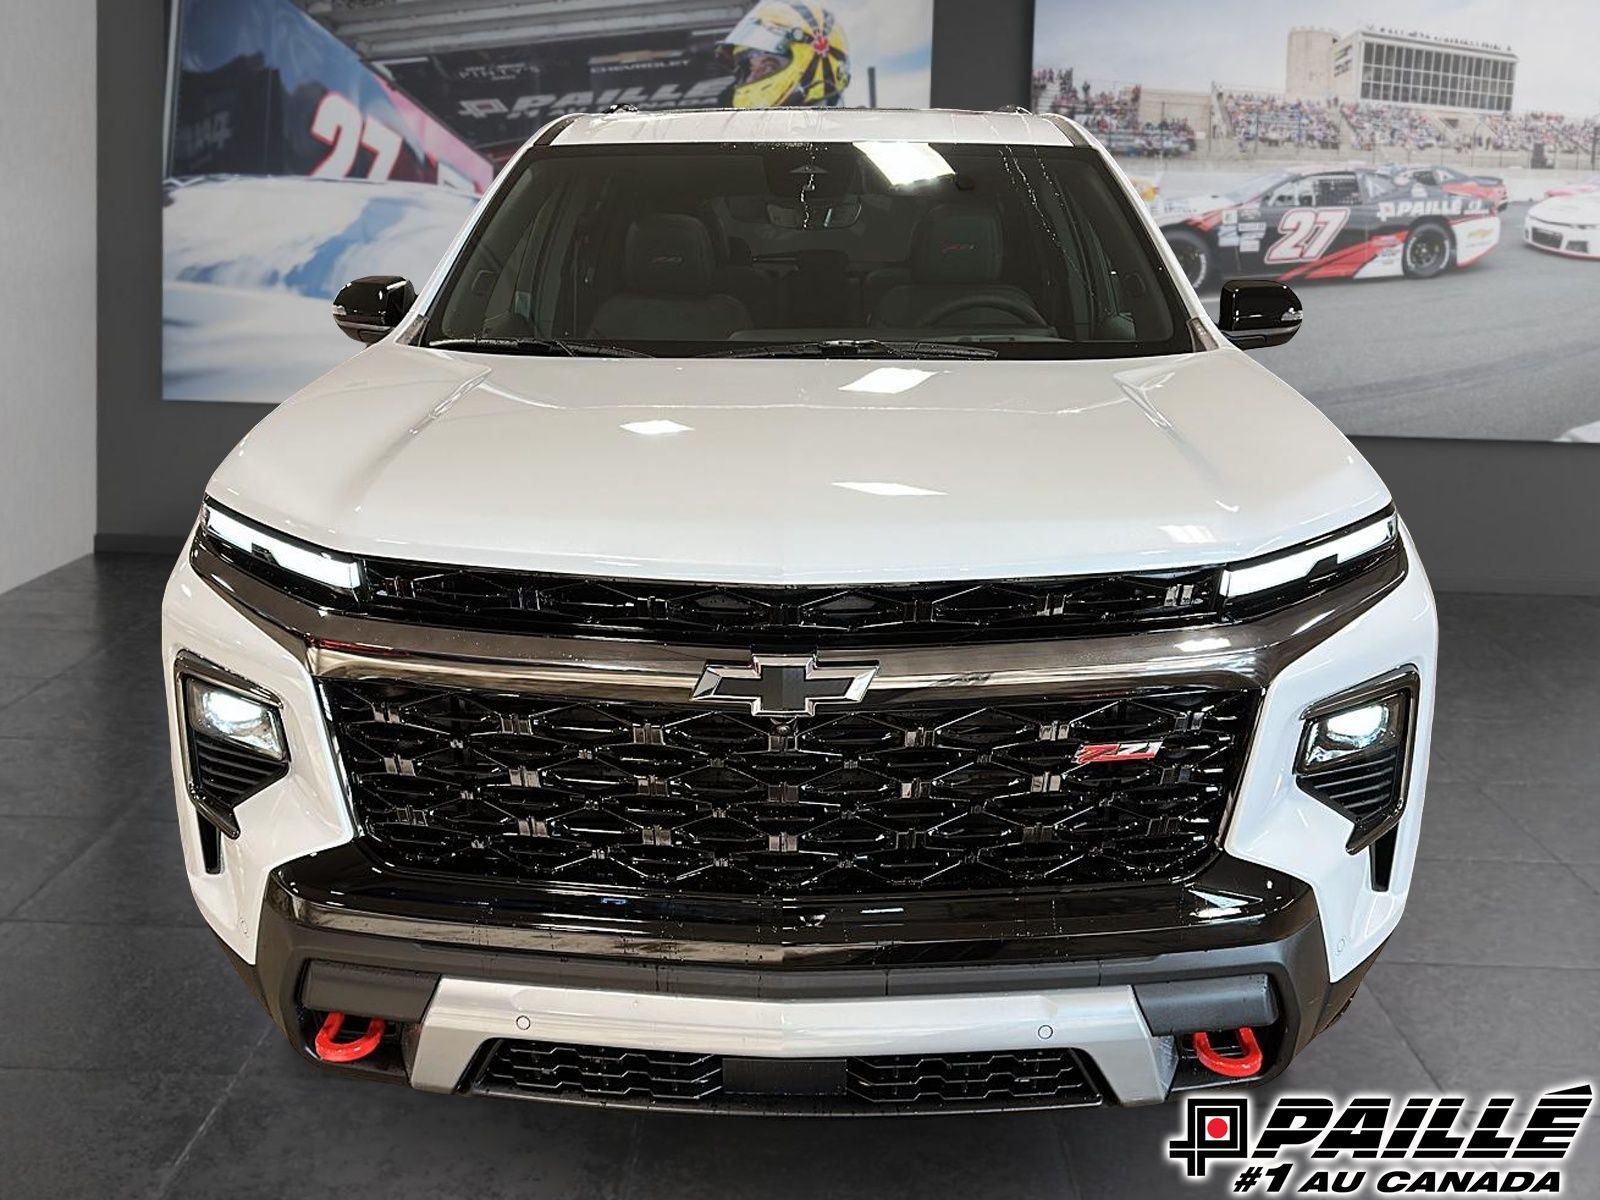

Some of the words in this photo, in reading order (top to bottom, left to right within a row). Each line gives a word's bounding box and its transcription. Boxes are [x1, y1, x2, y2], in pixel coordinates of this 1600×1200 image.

[310, 91, 402, 182] 27
[1264, 206, 1351, 264] 27
[1072, 741, 1163, 764] Z71
